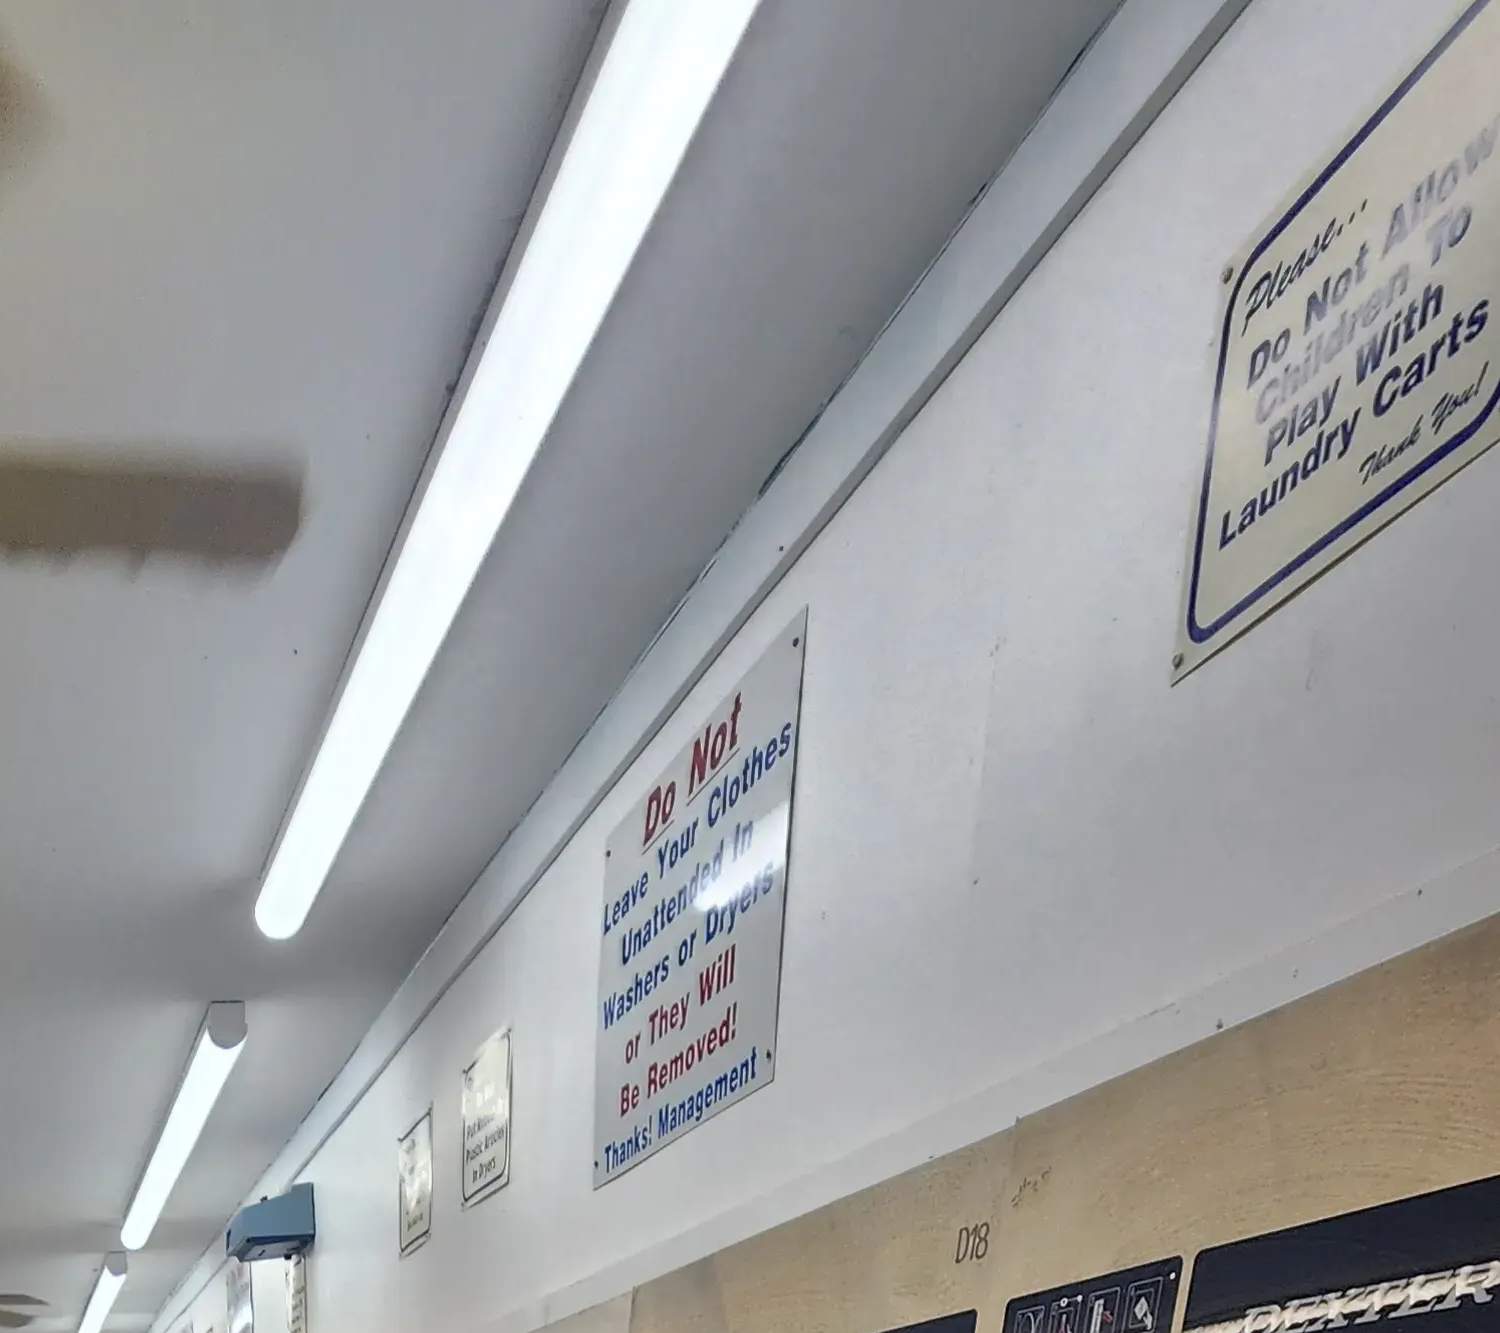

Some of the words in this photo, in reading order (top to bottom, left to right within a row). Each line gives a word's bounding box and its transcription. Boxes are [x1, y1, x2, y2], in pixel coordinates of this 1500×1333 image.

[1241, 197, 1368, 338] Please...
[1247, 327, 1291, 391] Do
[1303, 239, 1370, 337] Not
[1256, 263, 1411, 425] Children
[1426, 203, 1472, 268] To
[1218, 406, 1362, 552] Laundry
[1372, 299, 1490, 418] Carts
[1264, 375, 1342, 467] Play
[1356, 282, 1444, 387] With
[1358, 413, 1424, 486] Thank
[1431, 359, 1490, 436] You!
[603, 871, 649, 936] Leave
[657, 816, 699, 880] Your
[707, 721, 793, 828] Clothes
[642, 780, 677, 848] Do
[688, 691, 743, 798] Not
[604, 954, 670, 1031] Washers
[678, 928, 697, 967] or
[704, 861, 775, 945] Dryers
[621, 838, 725, 966] Unattended
[732, 820, 755, 862] In
[620, 1083, 640, 1118] Be
[646, 1001, 738, 1100] Removed!
[625, 1031, 641, 1065] or
[649, 992, 690, 1047] They
[699, 943, 736, 1007] Will
[605, 1115, 653, 1174] Thanks!
[657, 1046, 758, 1140] Management
[954, 1221, 991, 1265] D18
